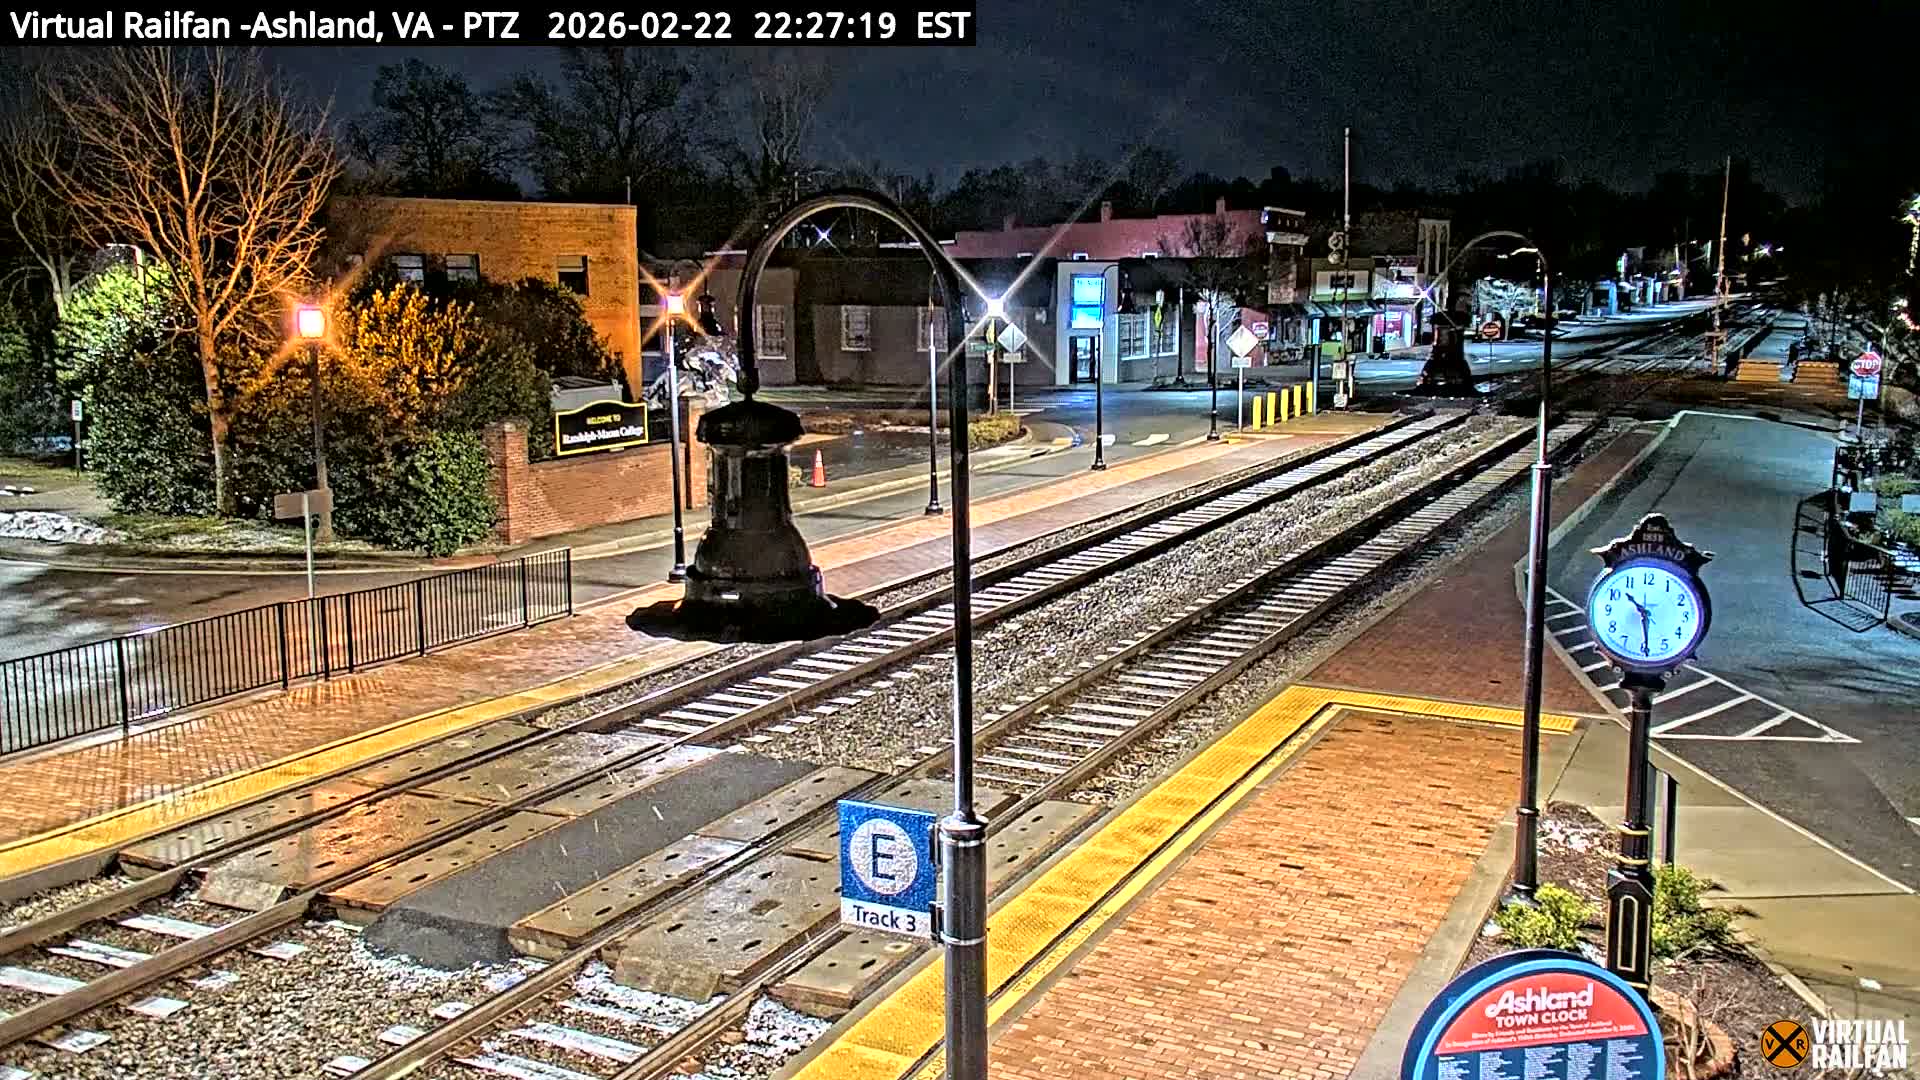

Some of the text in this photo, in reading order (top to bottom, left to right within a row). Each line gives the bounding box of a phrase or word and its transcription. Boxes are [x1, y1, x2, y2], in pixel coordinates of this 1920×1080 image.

[1853, 359, 1879, 369] STOP
[1619, 543, 1685, 561] ASHLAND
[1626, 576, 1634, 589] 11
[1644, 573, 1655, 585] 12
[1609, 589, 1621, 600] 10
[1677, 594, 1685, 606] 2
[1605, 604, 1612, 616] 9
[1682, 611, 1689, 623] 3
[1608, 621, 1616, 633] 8
[1675, 626, 1682, 639] 4
[1620, 635, 1628, 647] 7
[1660, 639, 1669, 650] 5
[872, 833, 896, 881] E
[853, 904, 916, 932] Track 3
[1485, 983, 1594, 1018] Ashland
[1496, 1009, 1587, 1028] TOWN CLOCK
